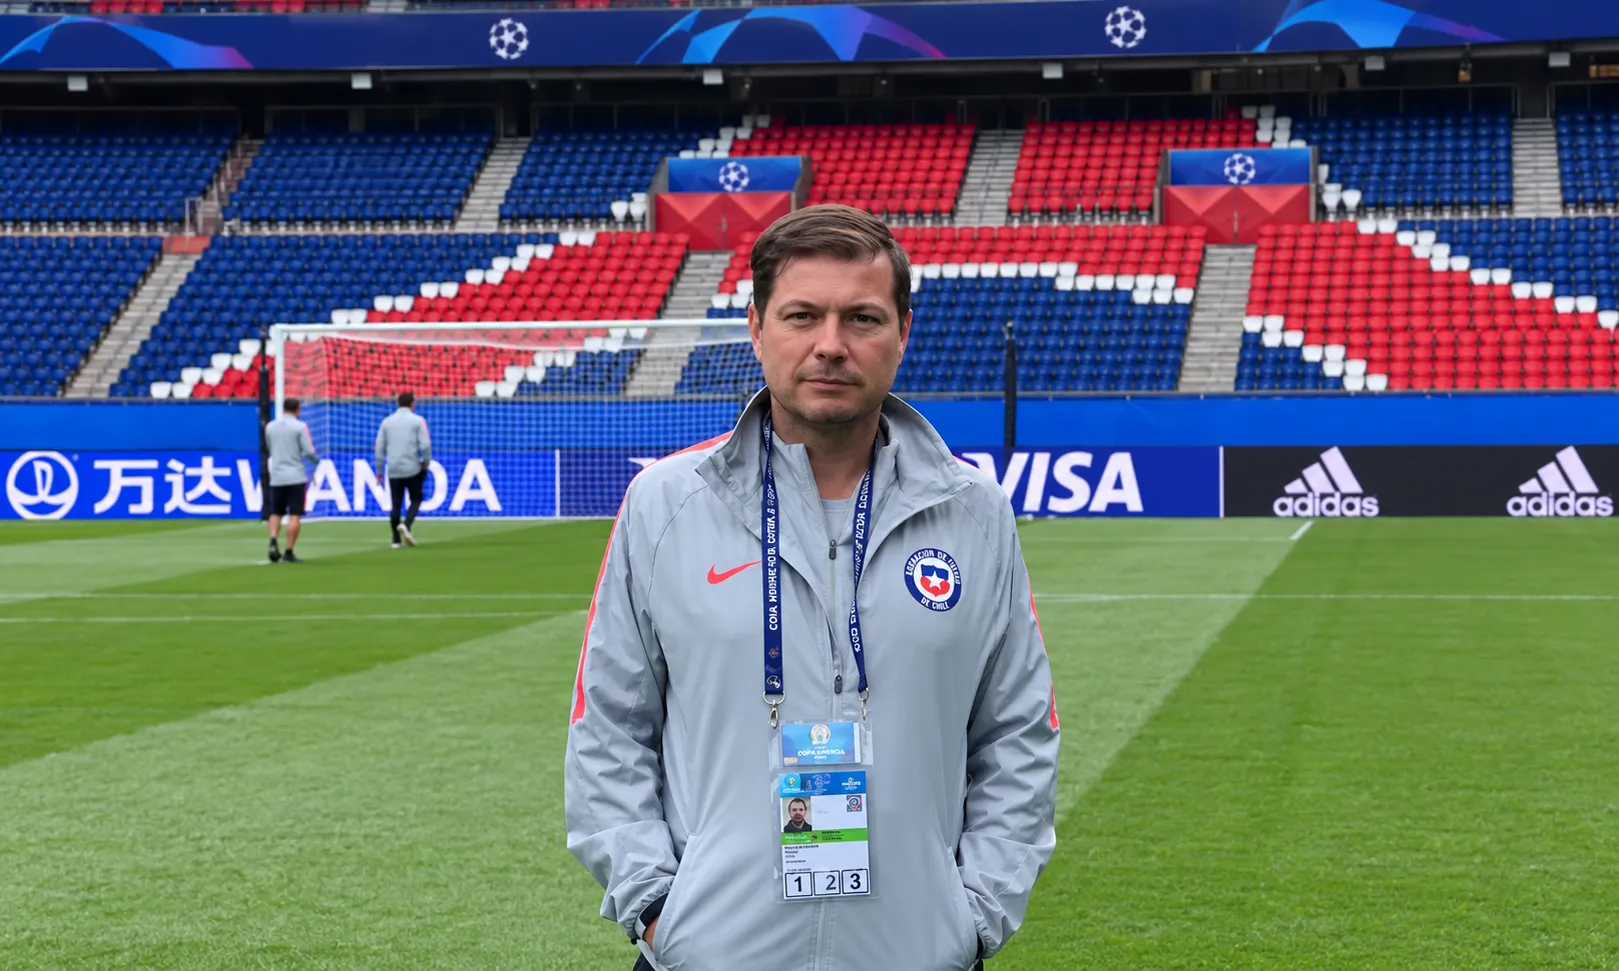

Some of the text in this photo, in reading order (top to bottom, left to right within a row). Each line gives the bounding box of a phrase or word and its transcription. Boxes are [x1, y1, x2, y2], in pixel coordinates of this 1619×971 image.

[93, 456, 232, 515] 万达
[961, 451, 1144, 513] VISA
[1272, 491, 1380, 517] adidas
[1506, 490, 1614, 517] adidas
[794, 873, 861, 892] 1 2 3
